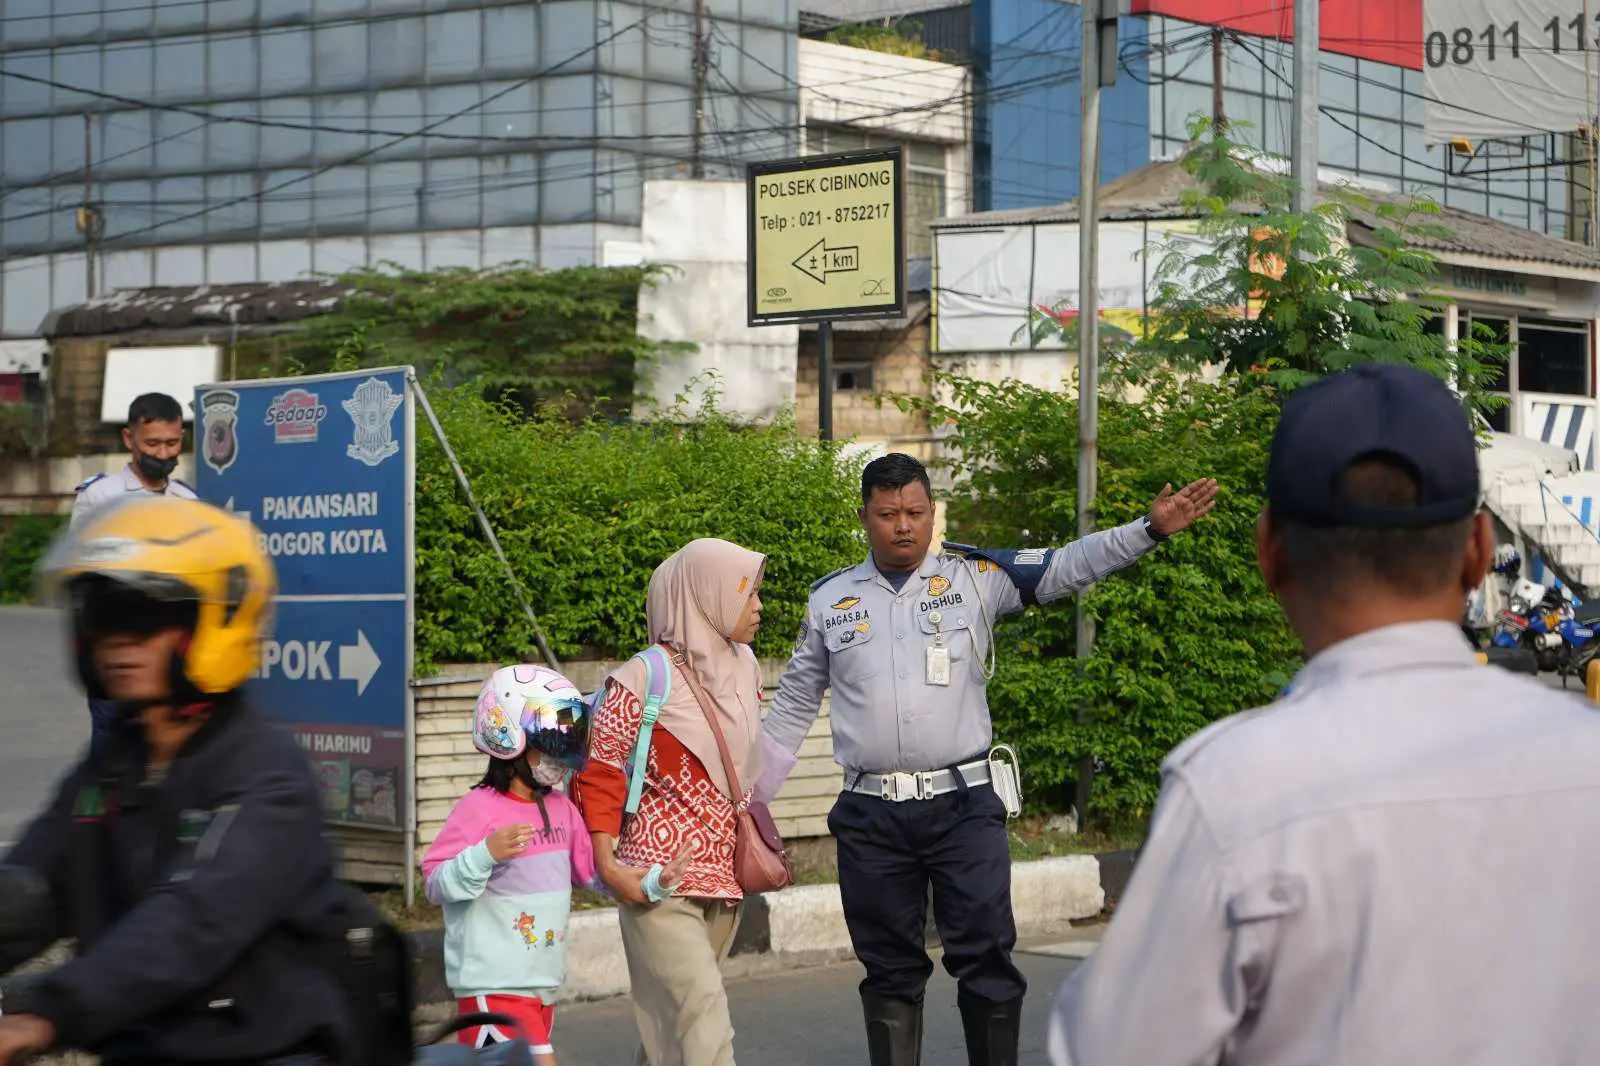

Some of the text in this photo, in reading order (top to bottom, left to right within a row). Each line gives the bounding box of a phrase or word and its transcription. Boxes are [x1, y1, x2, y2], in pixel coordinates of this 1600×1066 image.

[1426, 21, 1520, 67] 0811
[760, 170, 890, 199] POLSEK CIBINONG
[760, 214, 787, 232] Telp
[799, 210, 822, 227] 021
[834, 203, 890, 223] 8752217
[833, 252, 853, 268] km
[263, 492, 378, 520] PAKANSARI
[256, 529, 388, 557] BOGOR KOTA
[825, 609, 870, 629] BAGAS.B.A
[250, 639, 333, 681] POK
[314, 734, 372, 754] HARIMU
